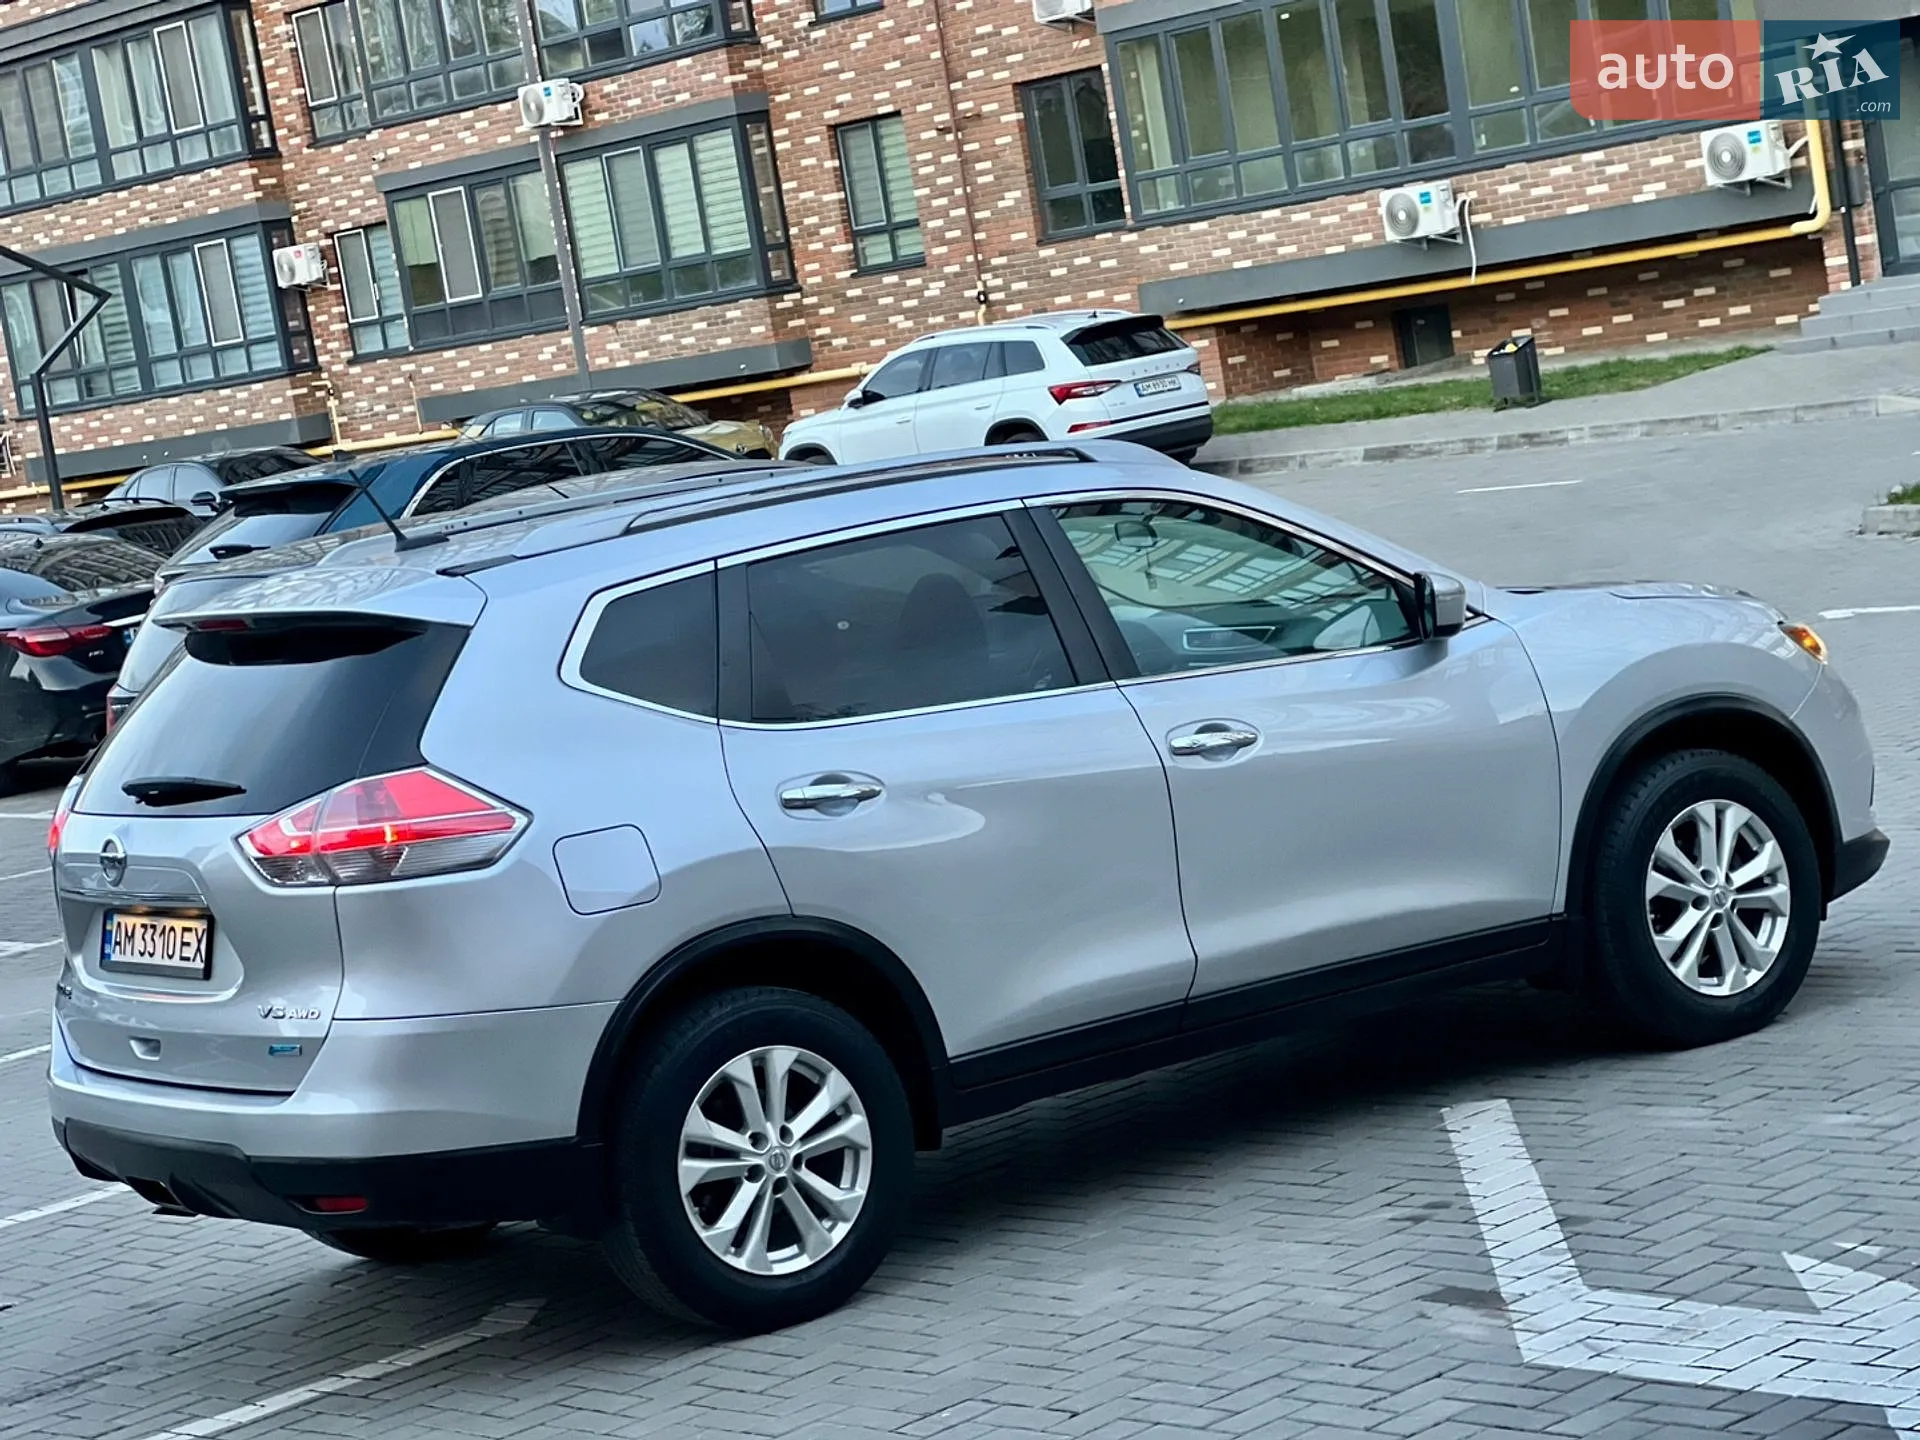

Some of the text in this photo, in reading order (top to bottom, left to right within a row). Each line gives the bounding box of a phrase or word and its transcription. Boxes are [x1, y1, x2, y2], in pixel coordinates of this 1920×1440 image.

[112, 921, 206, 964] AM 3310 EX
[288, 1008, 321, 1020] AWD
